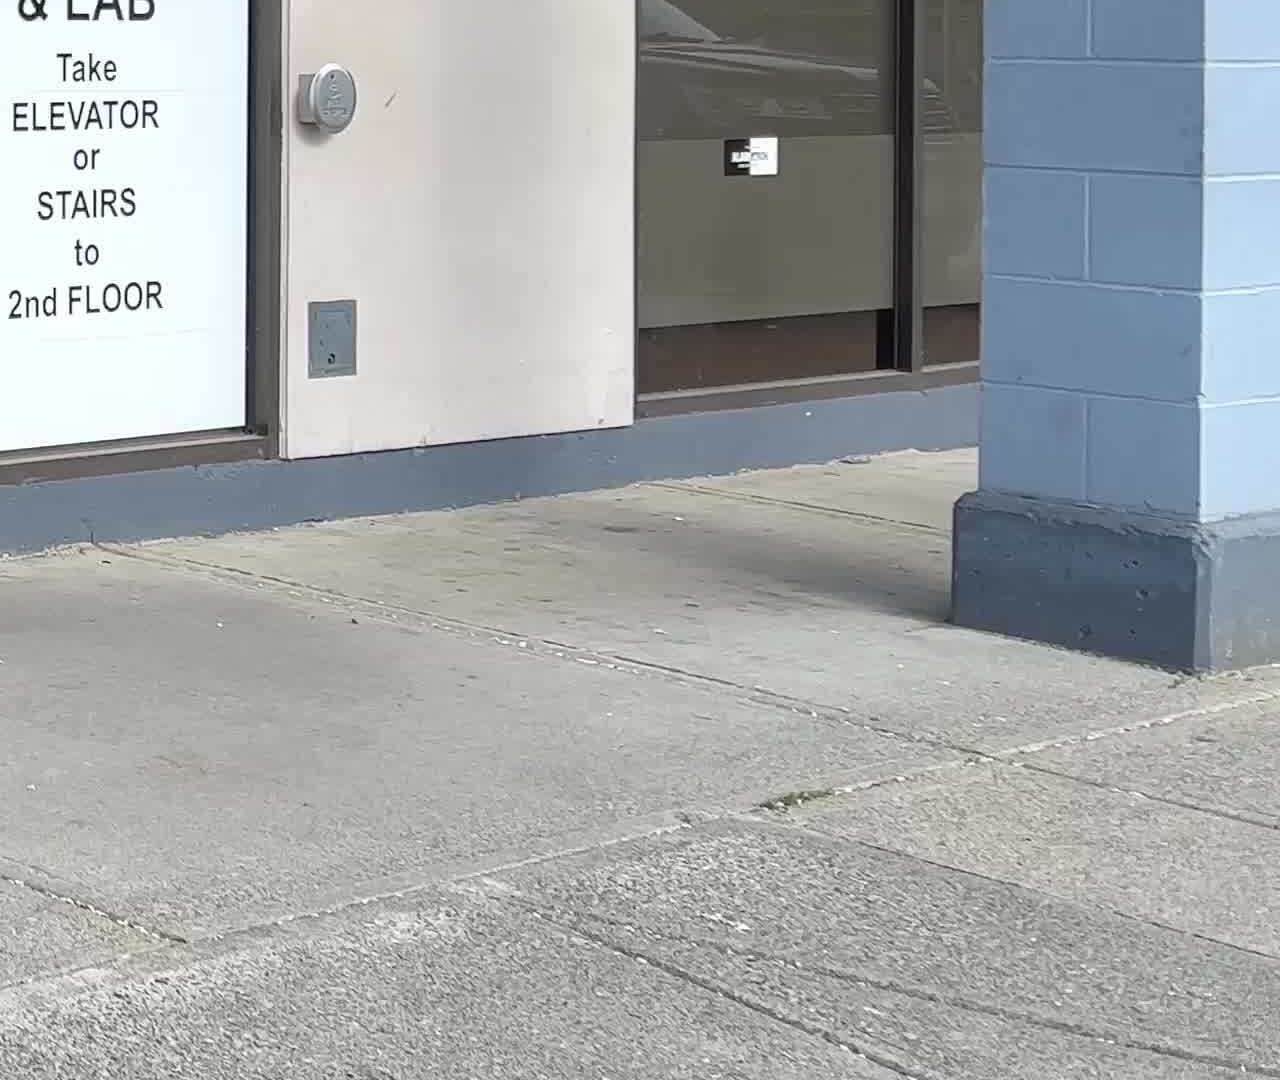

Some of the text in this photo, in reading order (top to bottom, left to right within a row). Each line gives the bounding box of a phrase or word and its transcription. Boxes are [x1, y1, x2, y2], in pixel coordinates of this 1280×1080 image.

[56, 53, 117, 82] Take
[12, 99, 160, 132] ELEVATOR
[73, 148, 100, 170] or
[37, 187, 137, 221] STAIRS
[74, 238, 100, 266] to
[8, 280, 164, 319] 2nd FLOOR
